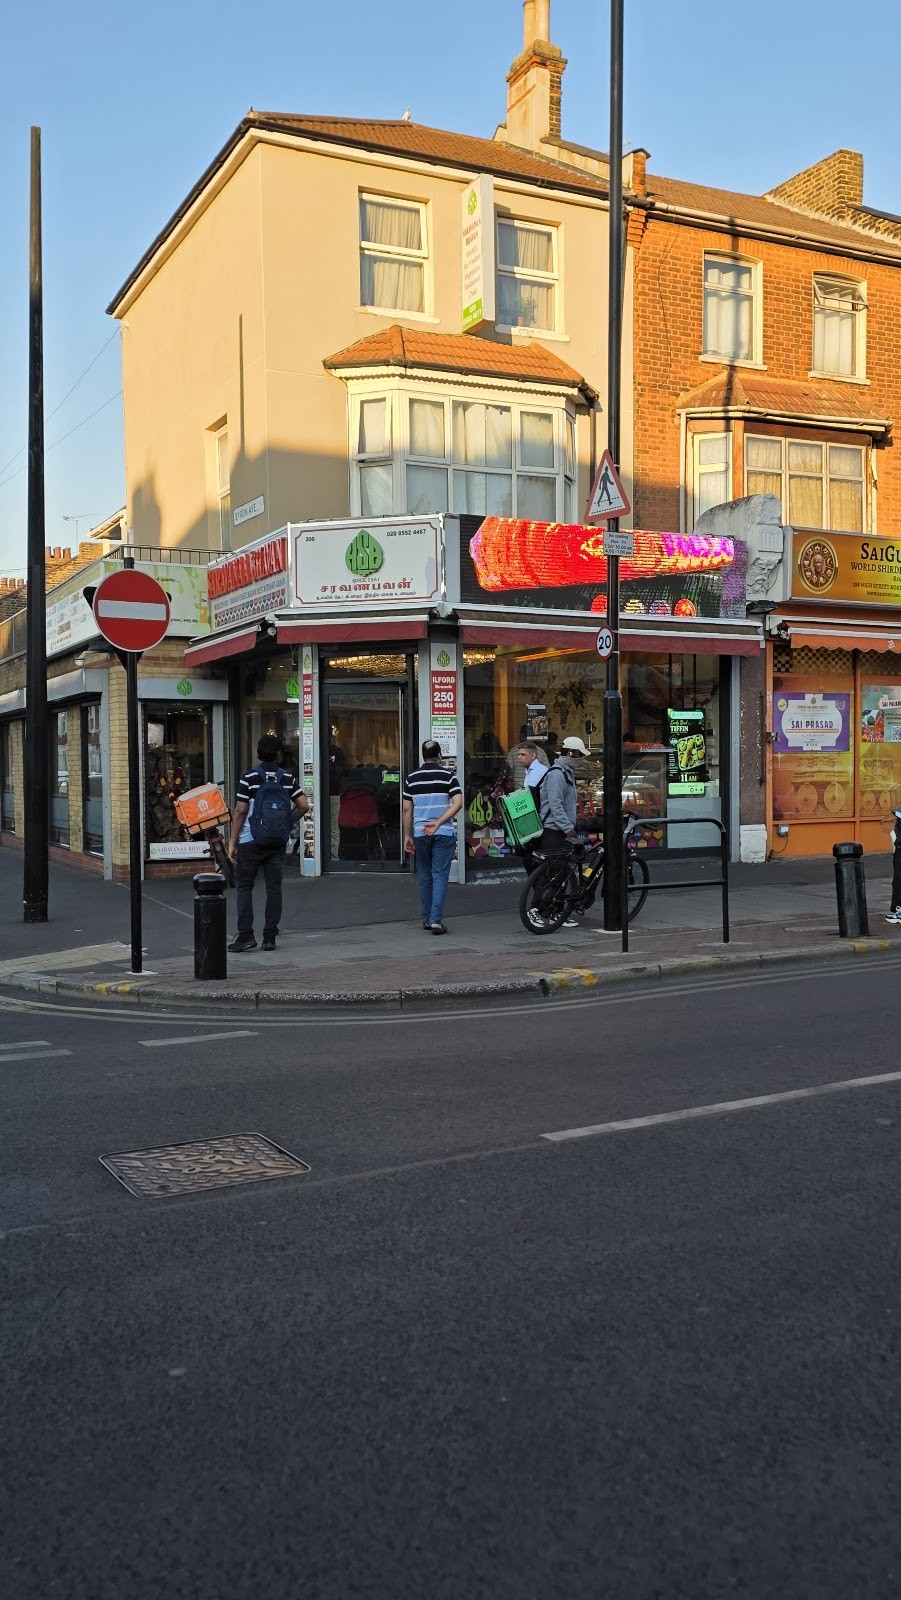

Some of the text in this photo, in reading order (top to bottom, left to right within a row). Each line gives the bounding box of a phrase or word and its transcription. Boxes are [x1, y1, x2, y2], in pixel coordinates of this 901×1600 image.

[850, 562, 877, 571] WORLD
[599, 635, 611, 650] 20
[432, 676, 455, 684] ILFORD
[433, 691, 454, 702] 250
[791, 720, 834, 728] SAI PRASAD
[680, 774, 688, 782] 11
[513, 799, 526, 808] Uber
[515, 804, 528, 813] Eats
